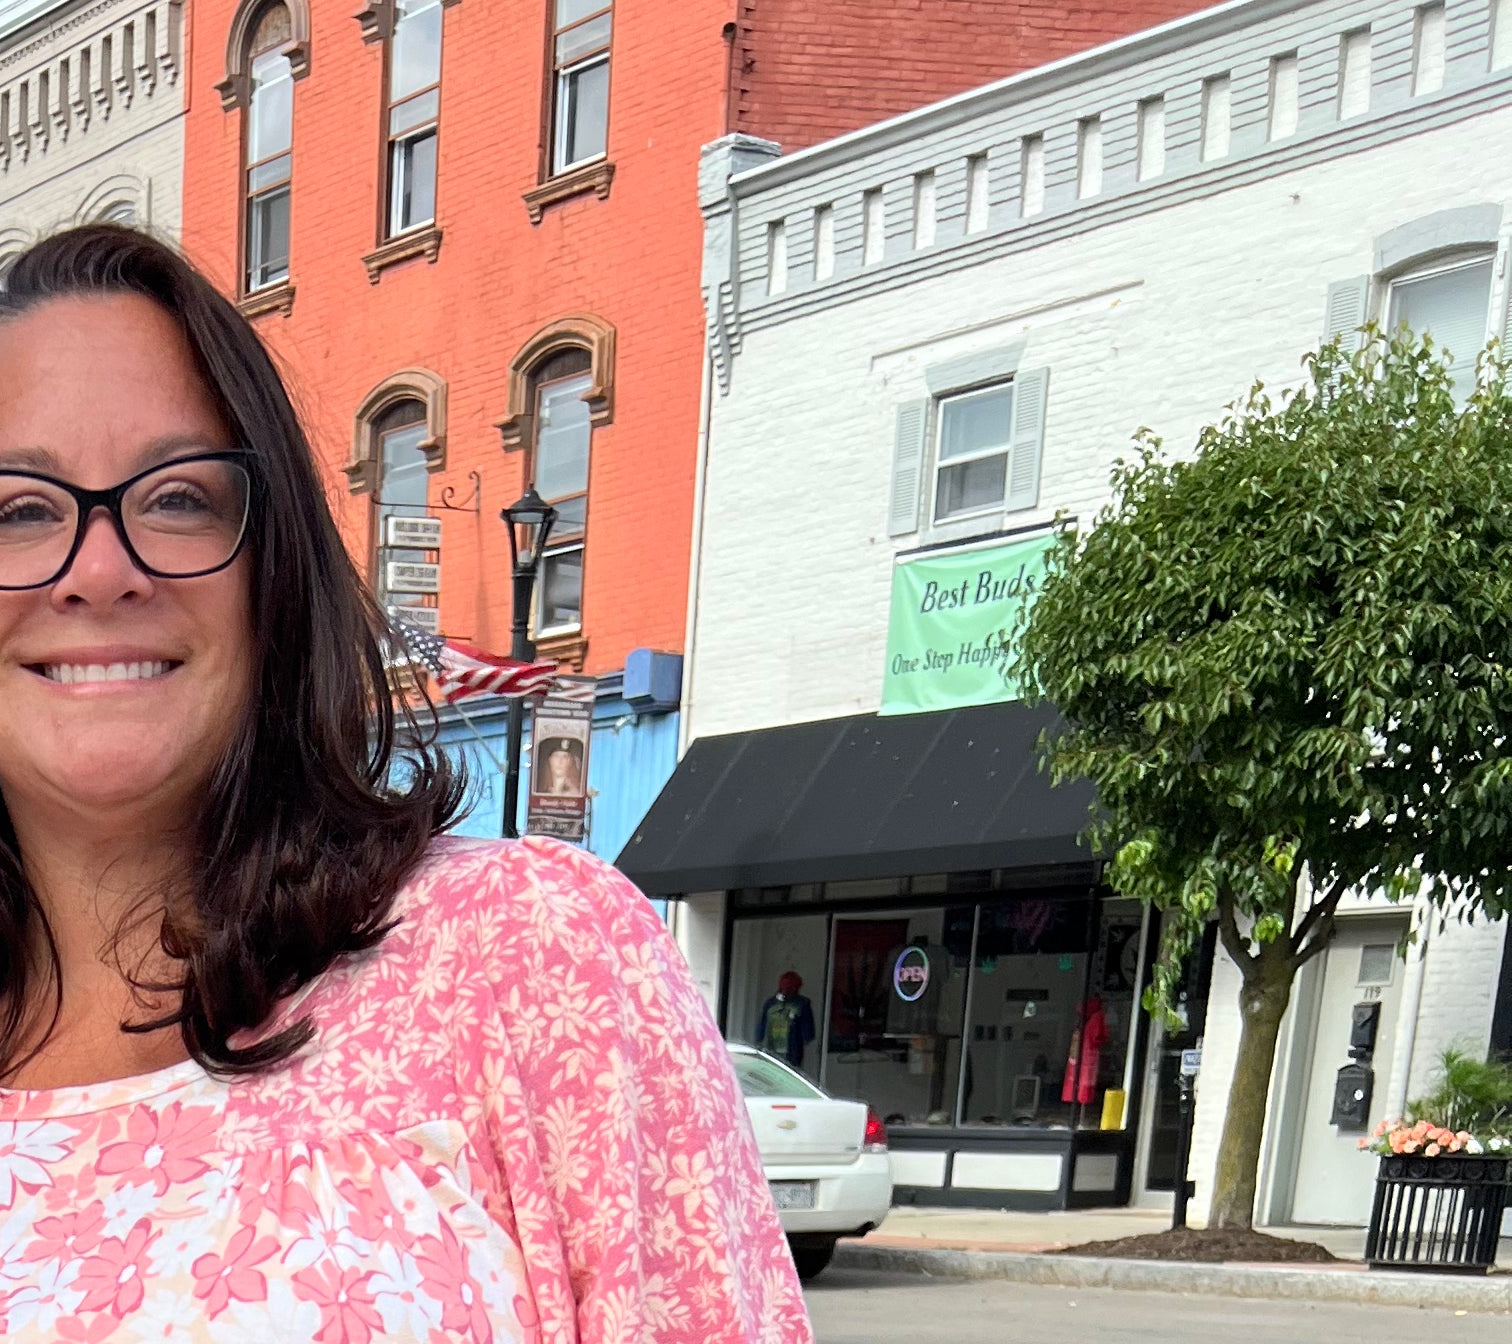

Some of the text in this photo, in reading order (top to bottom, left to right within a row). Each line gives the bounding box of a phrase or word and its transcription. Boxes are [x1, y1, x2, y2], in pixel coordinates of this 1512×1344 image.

[920, 563, 1036, 614] Best Buds
[892, 653, 919, 675] One
[898, 966, 928, 982] OPEN
